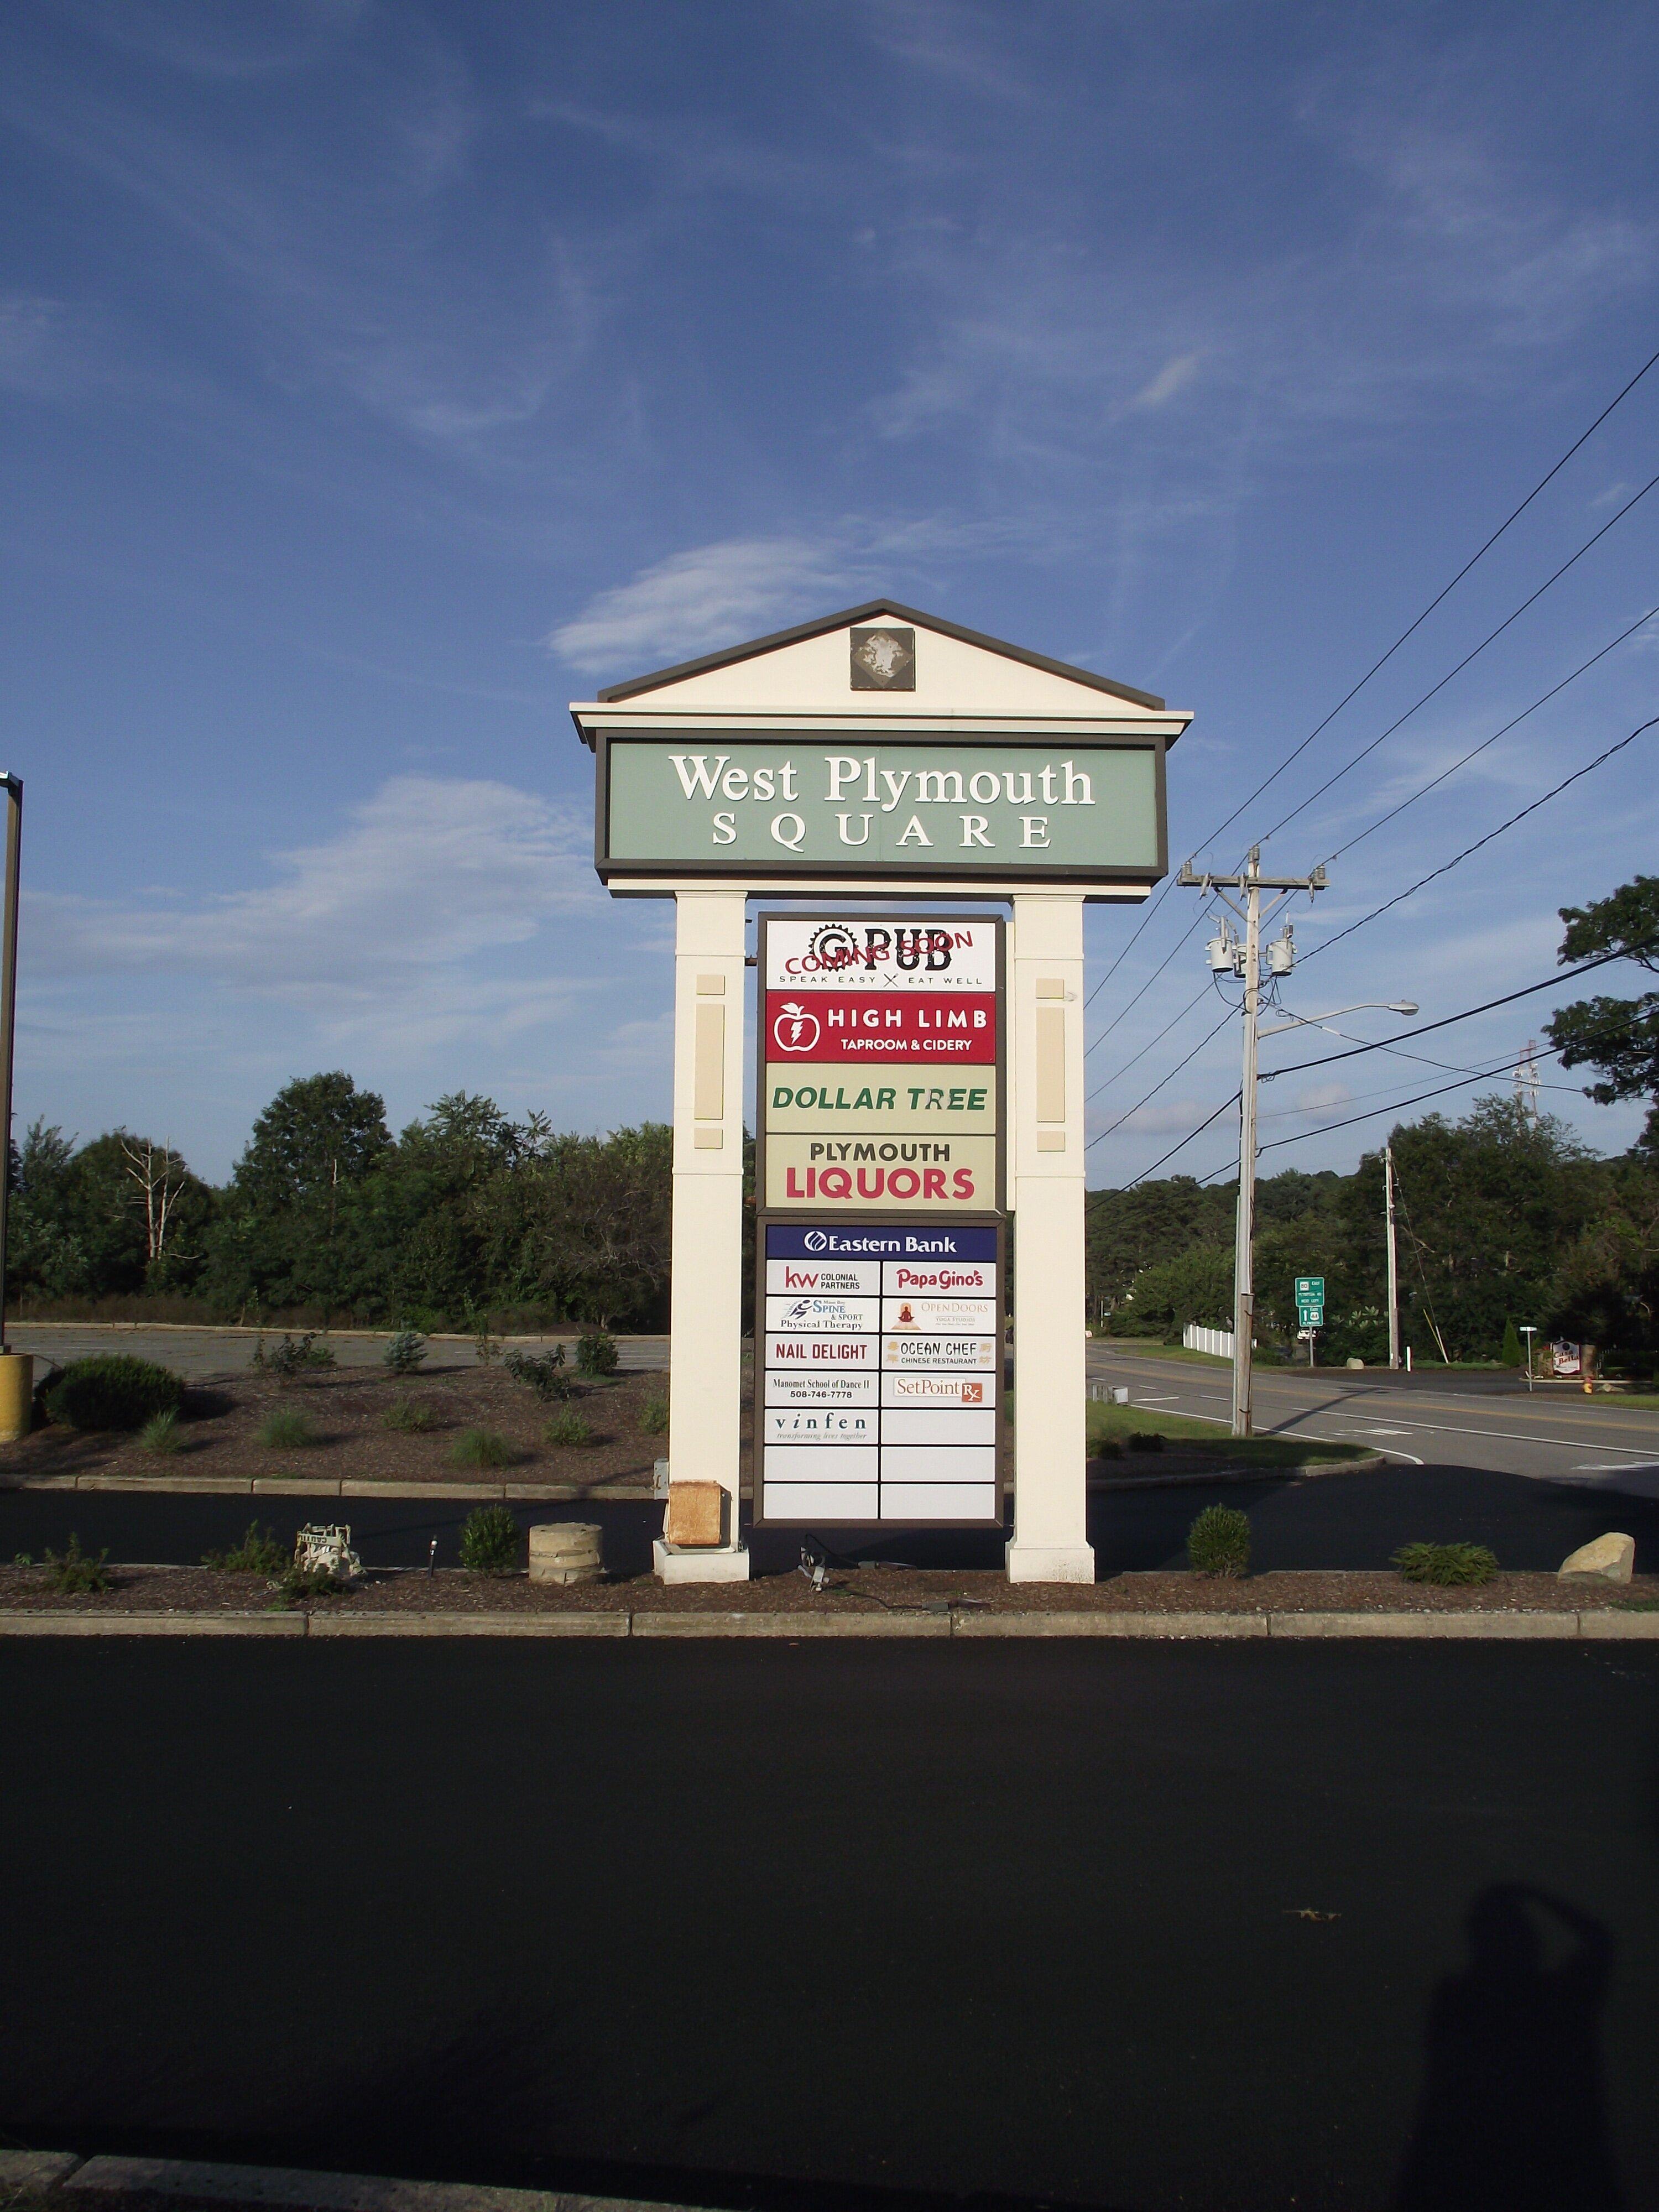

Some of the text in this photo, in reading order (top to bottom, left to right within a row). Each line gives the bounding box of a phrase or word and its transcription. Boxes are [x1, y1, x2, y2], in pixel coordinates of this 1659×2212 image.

[668, 755, 1095, 812] West Plymouth
[712, 812, 1052, 853] SQUARE
[785, 930, 974, 974] COMING SOON
[864, 928, 953, 971] PUB
[827, 1009, 988, 1029] HIGH LIMB
[840, 1039, 973, 1051] TAPROOM & CIDERY
[773, 1087, 988, 1111] DOLLAR TREE
[810, 1142, 951, 1162] PLYMOUTH
[786, 1167, 975, 1200] LIQUORS
[829, 1236, 957, 1253] Eastern Bank
[785, 1265, 819, 1288] kw
[896, 1268, 983, 1290] Papa Gino's
[813, 1300, 845, 1313] SPINE
[780, 1319, 863, 1331] Physical Therapy
[776, 1343, 807, 1359] NAIL
[812, 1344, 868, 1360] DELIGHT
[900, 1342, 941, 1355] OCEAN
[946, 1342, 977, 1355] CHEF
[773, 1379, 870, 1389] Manomet School of Dance II
[775, 1412, 866, 1430] vinfen
[776, 1432, 821, 1441] transforming
[840, 1432, 867, 1441] together
